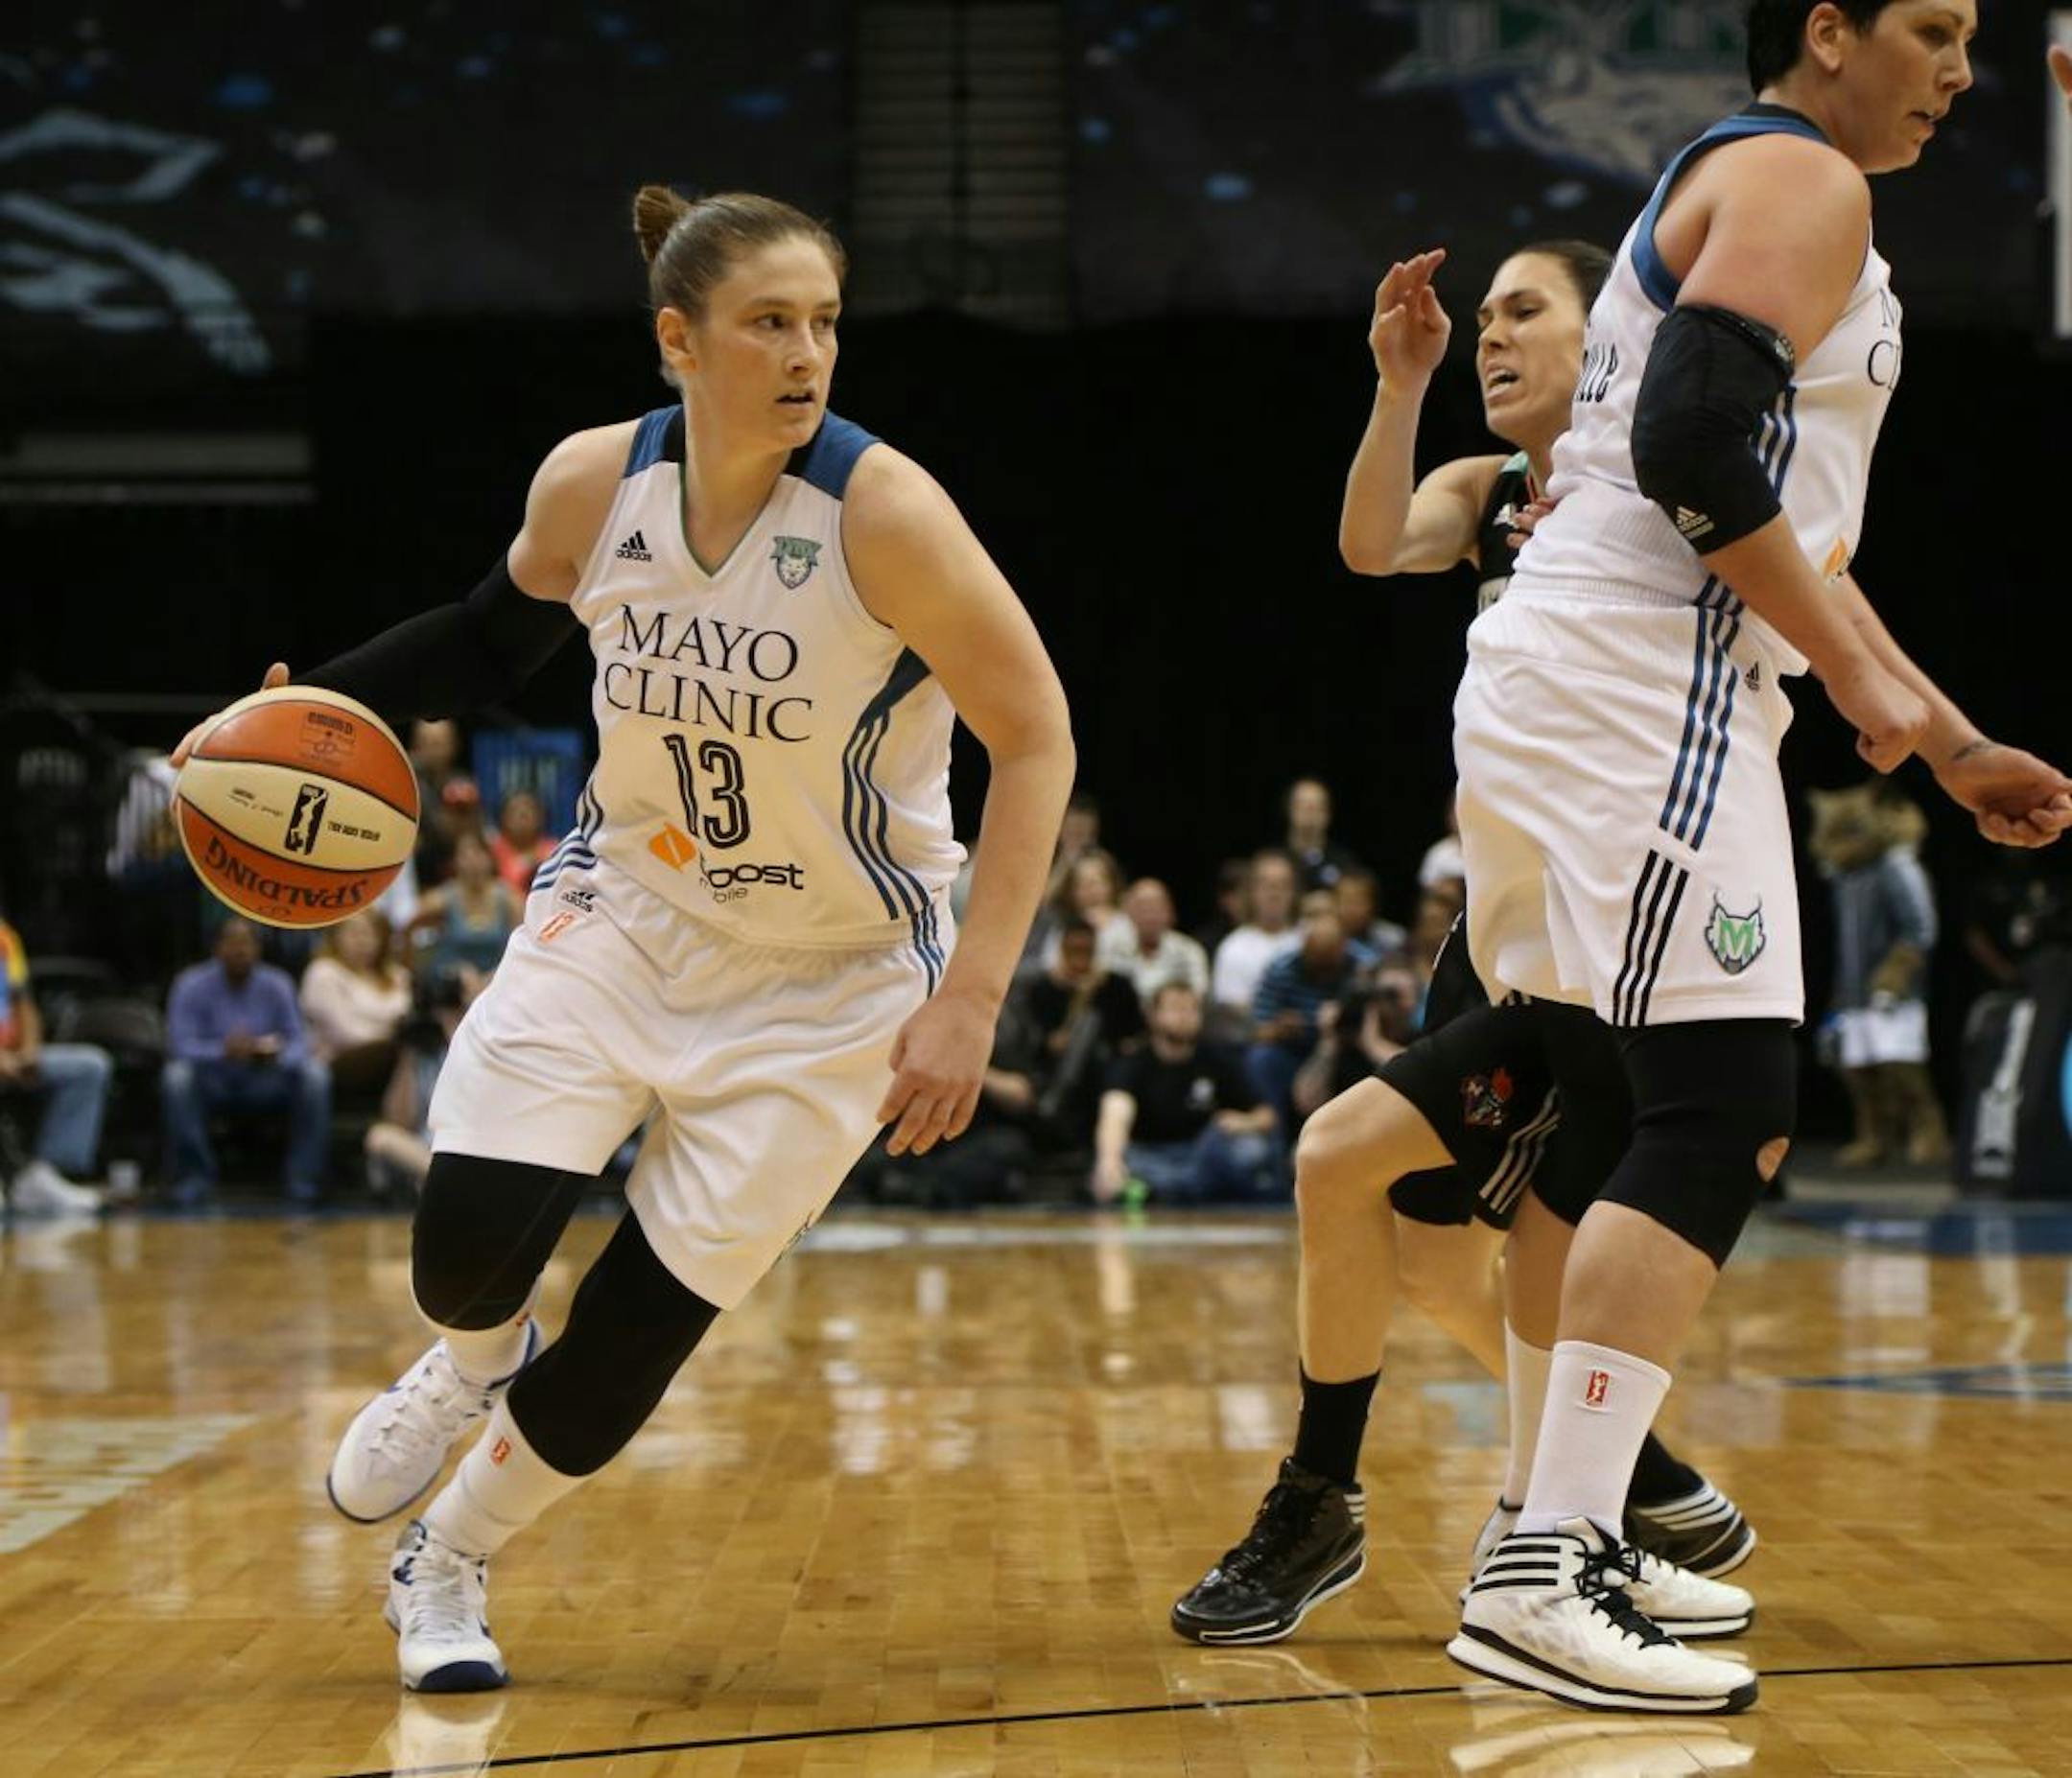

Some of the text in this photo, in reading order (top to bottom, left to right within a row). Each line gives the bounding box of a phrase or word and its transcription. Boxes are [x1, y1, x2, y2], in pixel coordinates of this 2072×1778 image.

[615, 548, 652, 562] adidas
[617, 604, 798, 682] MAYO
[604, 663, 813, 742] CLINIC
[662, 734, 751, 849] 13
[204, 836, 368, 907] SPALDING
